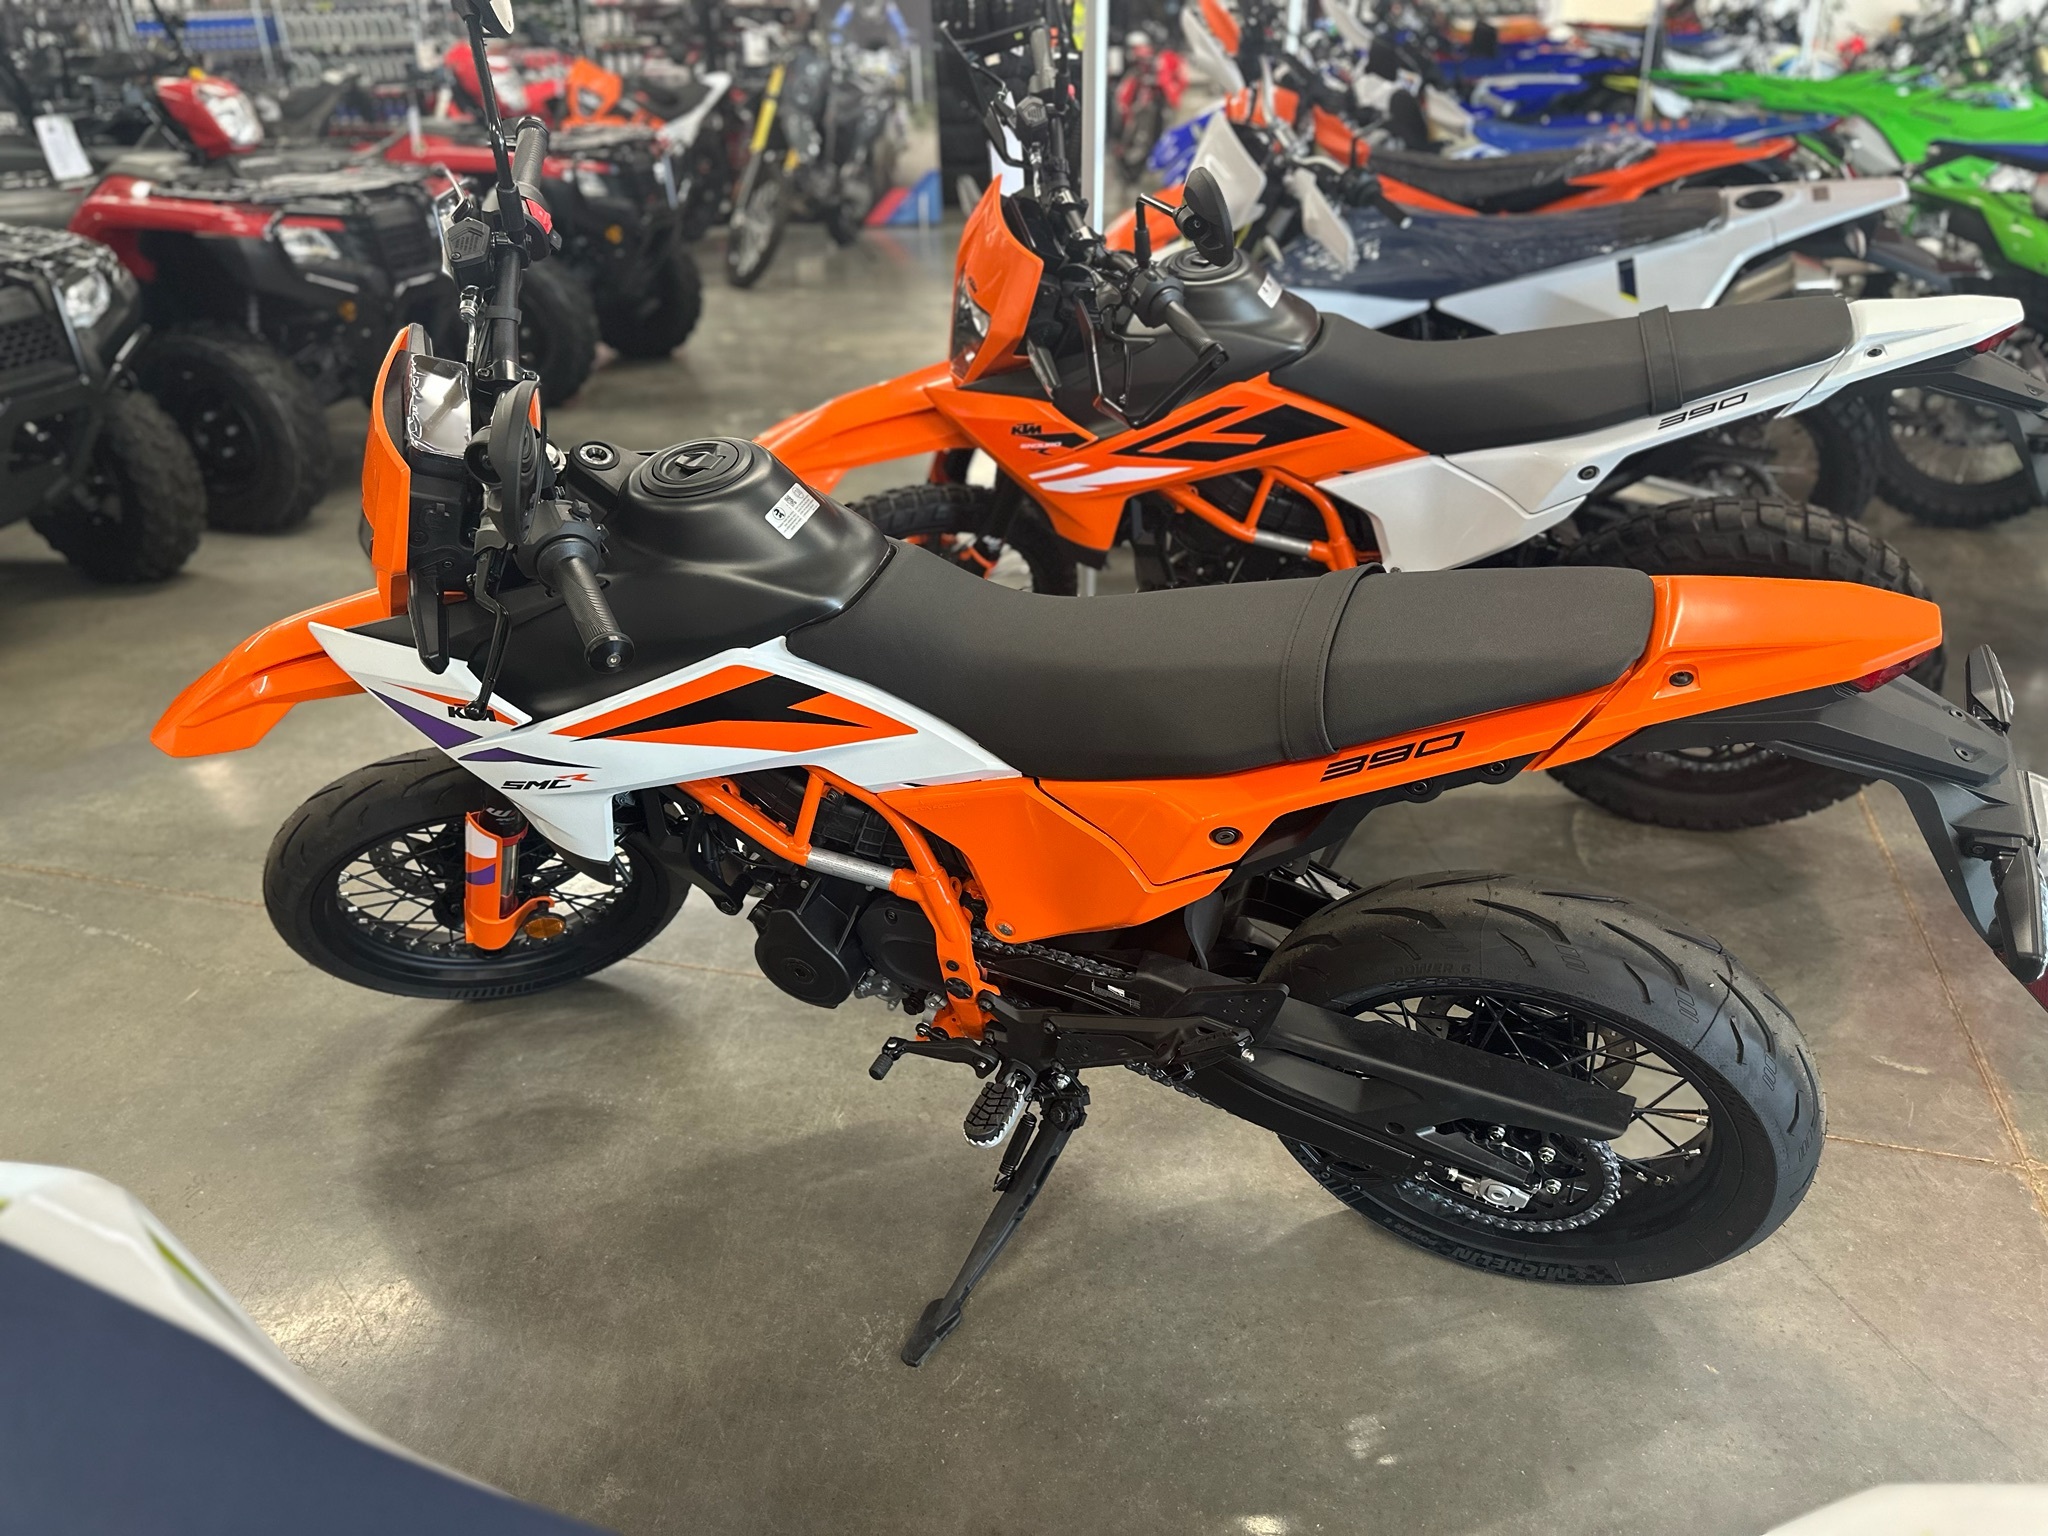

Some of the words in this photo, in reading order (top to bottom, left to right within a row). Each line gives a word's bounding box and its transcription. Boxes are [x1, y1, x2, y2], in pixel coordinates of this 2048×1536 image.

[1658, 392, 1748, 430] 390
[1011, 423, 1042, 435] KTM
[447, 703, 496, 722] KM
[1320, 731, 1465, 782] 390
[1451, 1247, 1569, 1280] MICHELIN
